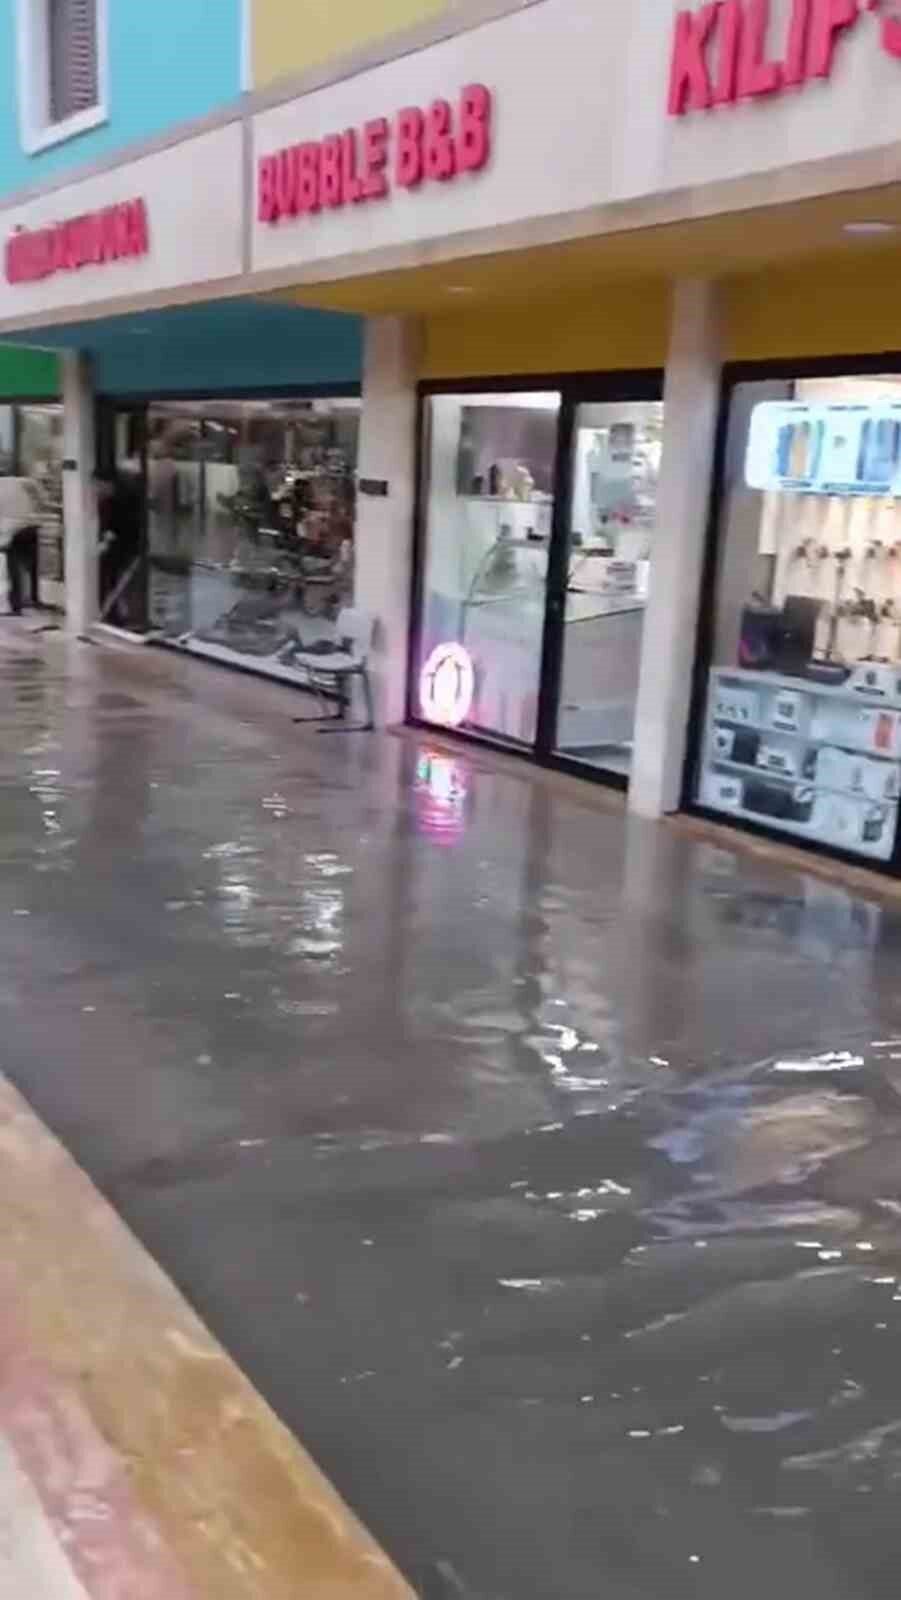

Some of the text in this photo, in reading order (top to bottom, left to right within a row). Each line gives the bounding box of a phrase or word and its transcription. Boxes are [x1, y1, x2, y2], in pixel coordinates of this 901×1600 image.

[668, 0, 901, 115] KILIP'
[259, 83, 491, 222] BUBBLE B&B
